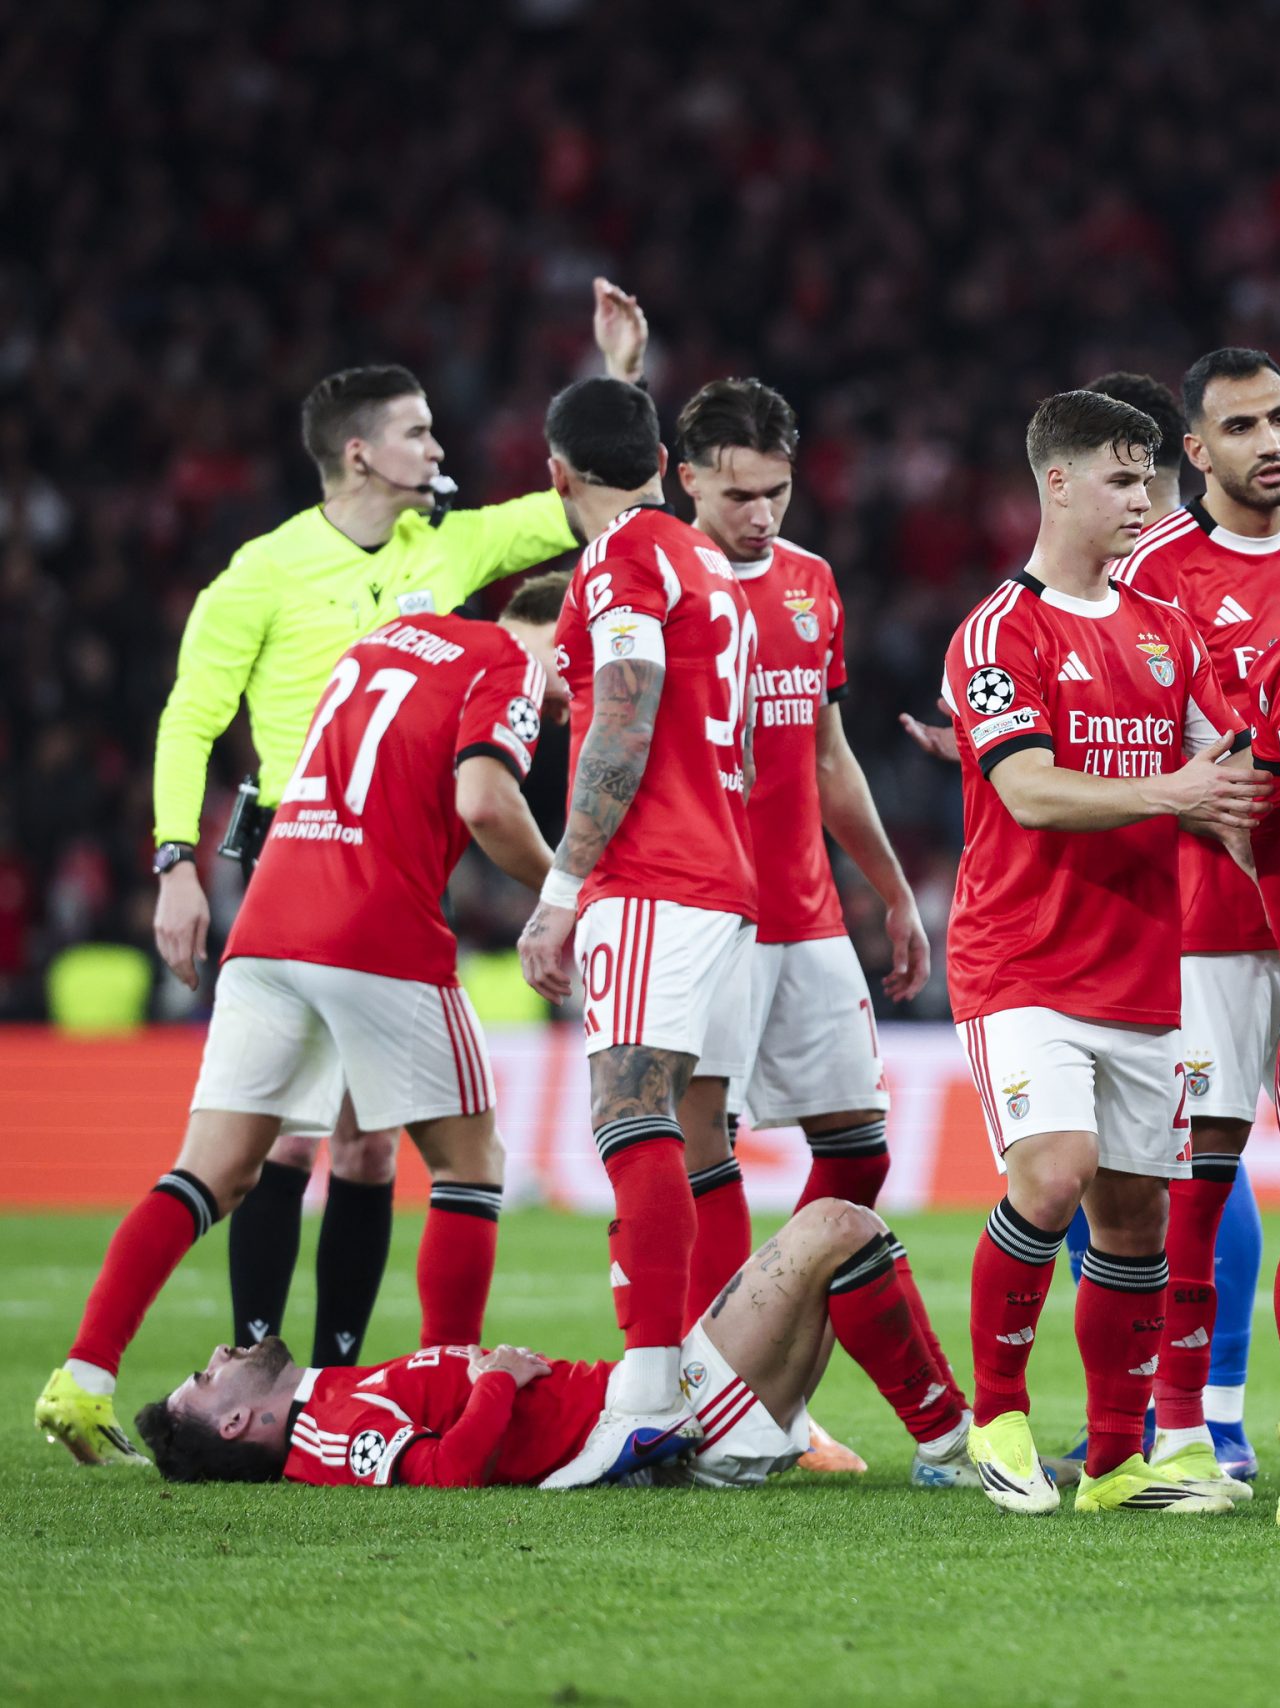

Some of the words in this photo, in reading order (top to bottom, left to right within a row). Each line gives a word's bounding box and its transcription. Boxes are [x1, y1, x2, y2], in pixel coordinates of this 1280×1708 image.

[360, 621, 466, 666] LDERUP
[750, 663, 821, 697] irates
[762, 698, 814, 728] BETTER
[281, 657, 418, 816] 27
[1083, 748, 1114, 776] FLY
[271, 822, 363, 846] FOUNDATION
